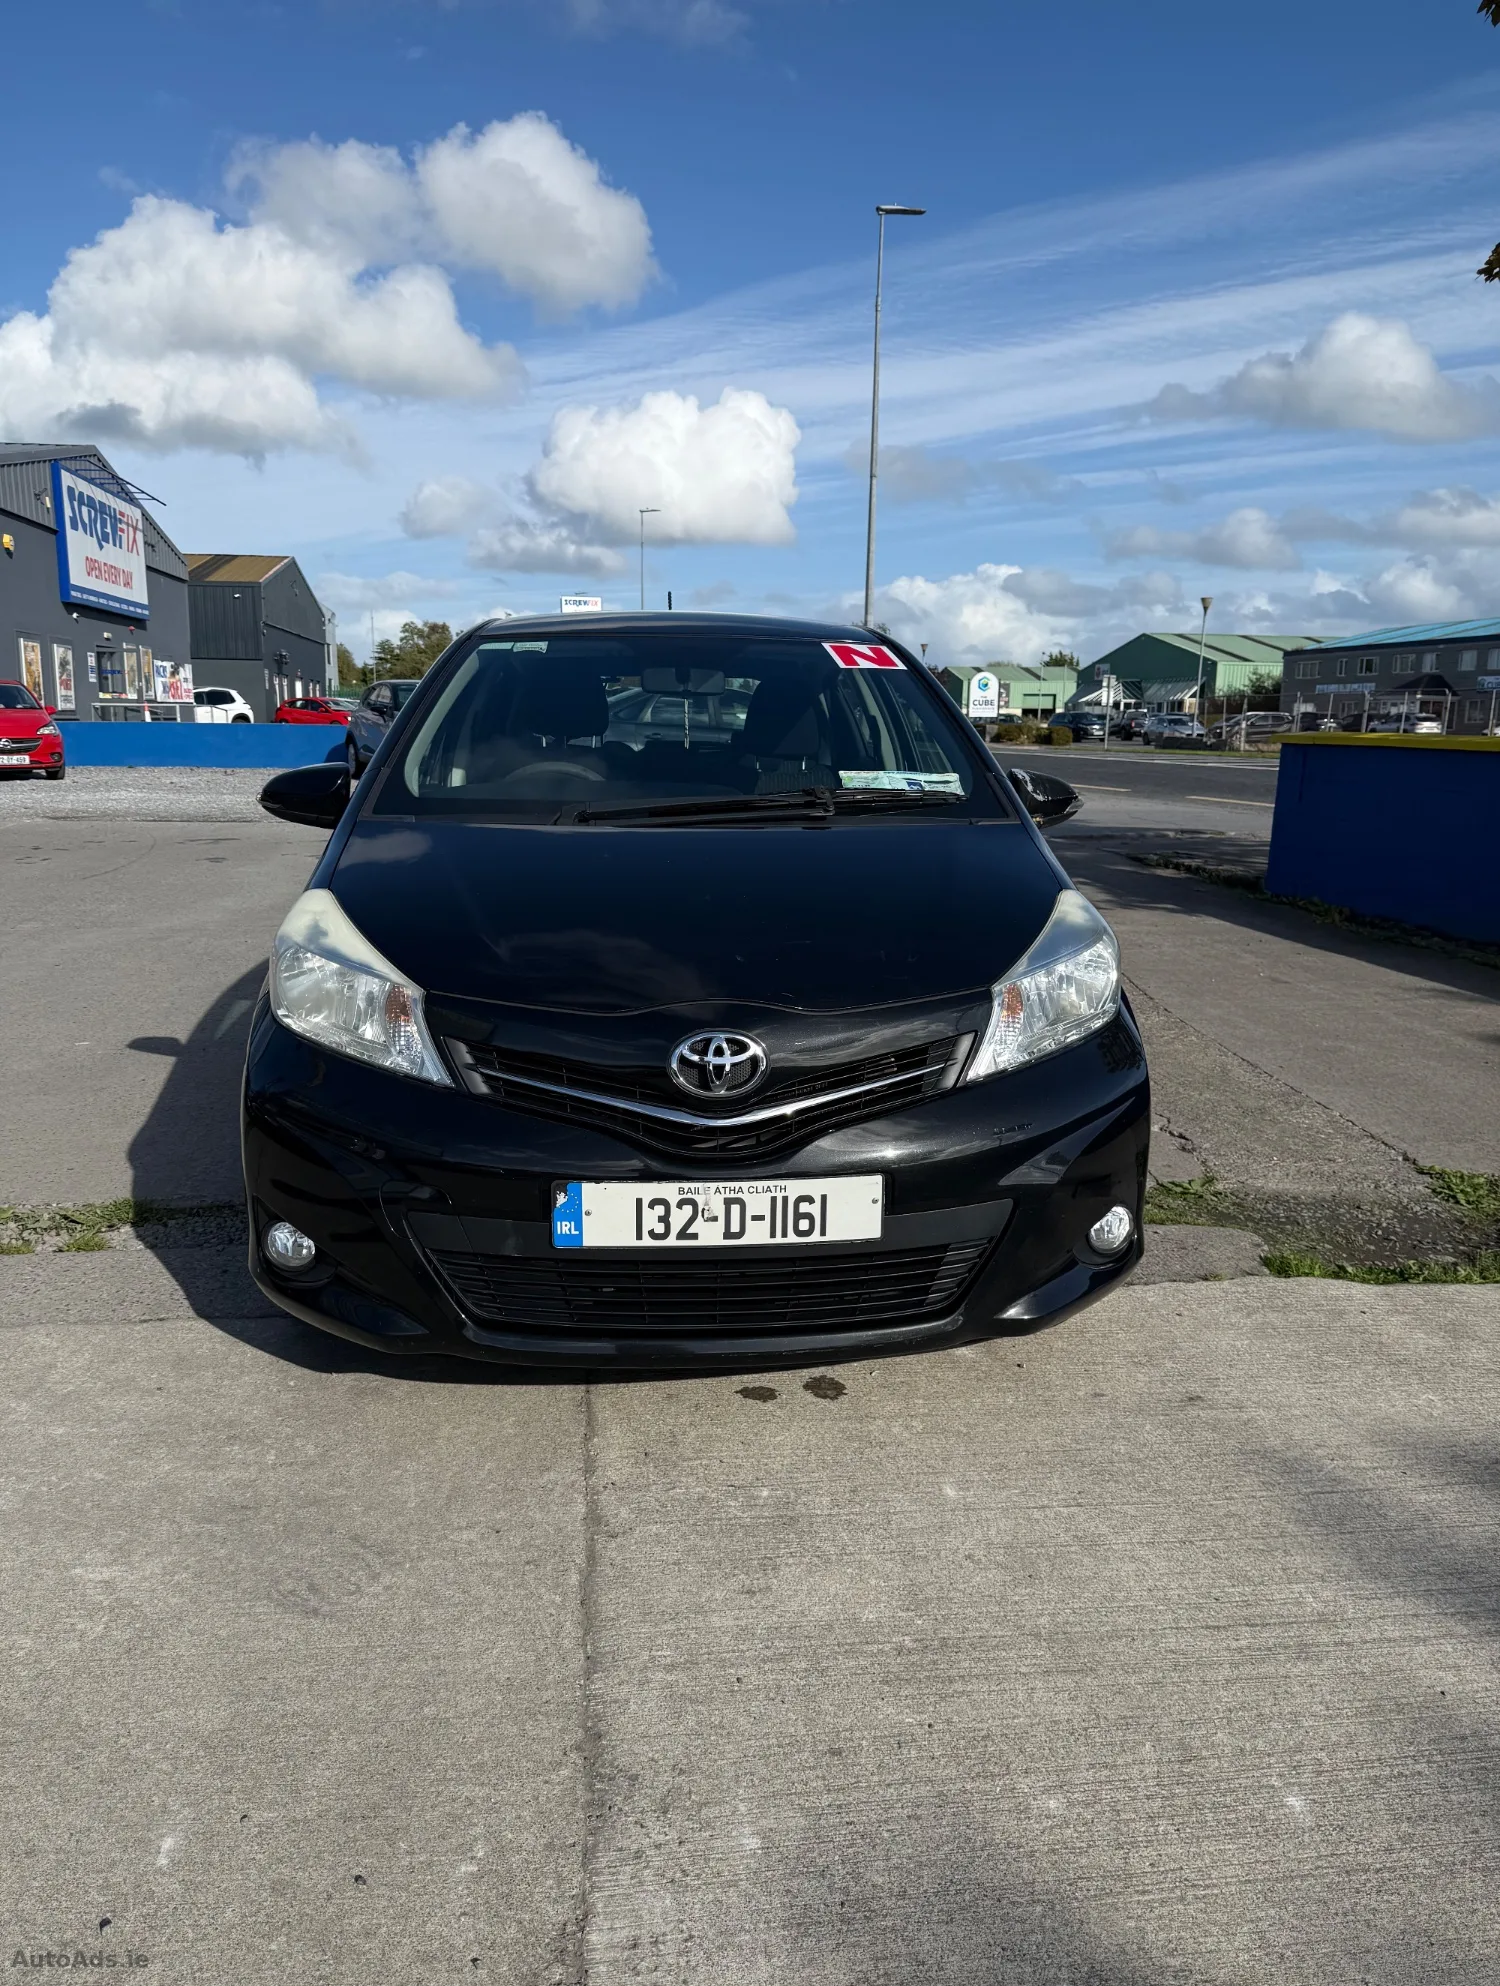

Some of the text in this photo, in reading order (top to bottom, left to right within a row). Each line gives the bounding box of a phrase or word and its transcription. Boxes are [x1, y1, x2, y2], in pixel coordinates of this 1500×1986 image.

[67, 485, 140, 556] SCREWFIX
[85, 556, 133, 590] OPEN EVERY DAY
[564, 599, 599, 607] SCREWFIX
[829, 645, 899, 668] N
[972, 699, 995, 707] CUBE
[678, 1184, 787, 1196] BAILE ÁTHA CLIATH
[635, 1193, 828, 1241] 132-D-1161
[556, 1221, 579, 1235] IRL
